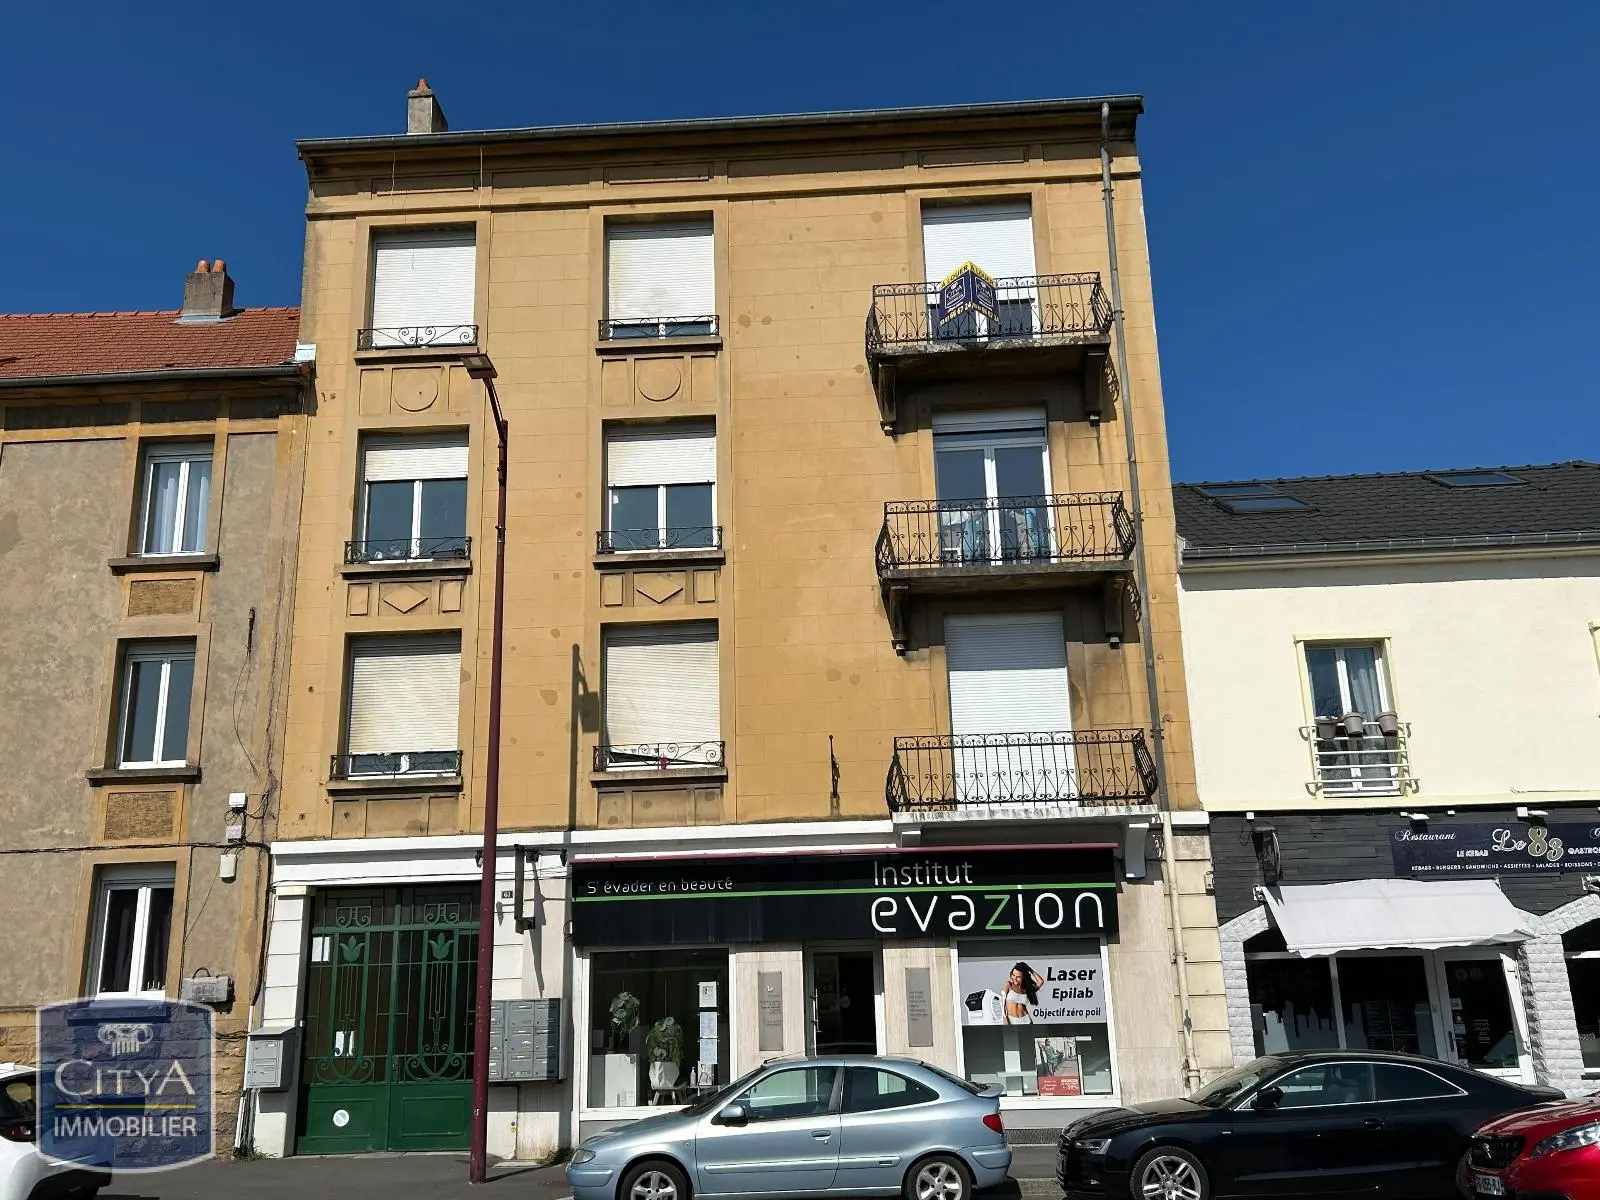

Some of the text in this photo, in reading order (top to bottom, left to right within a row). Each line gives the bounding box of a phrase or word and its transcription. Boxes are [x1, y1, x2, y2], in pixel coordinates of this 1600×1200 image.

[1394, 828, 1456, 842] Restaurant
[1491, 828, 1527, 852] Le
[1527, 826, 1564, 861] 83
[1456, 849, 1489, 858] LE KEBAB
[874, 860, 973, 886] Institut
[1412, 864, 1432, 872] KEBABS
[1436, 863, 1461, 871] BURGERS
[1465, 862, 1499, 870] SANDWICHS
[1503, 862, 1531, 870] ASSIETTES
[1564, 860, 1593, 868] BOISSONS
[603, 879, 653, 894] évader
[659, 881, 676, 892] en
[681, 877, 733, 891] beauté
[870, 884, 1104, 933] evazion
[1046, 966, 1096, 982] Laser
[1052, 987, 1094, 1001] Epilab
[1033, 1006, 1101, 1019] Objectif zéro poil
